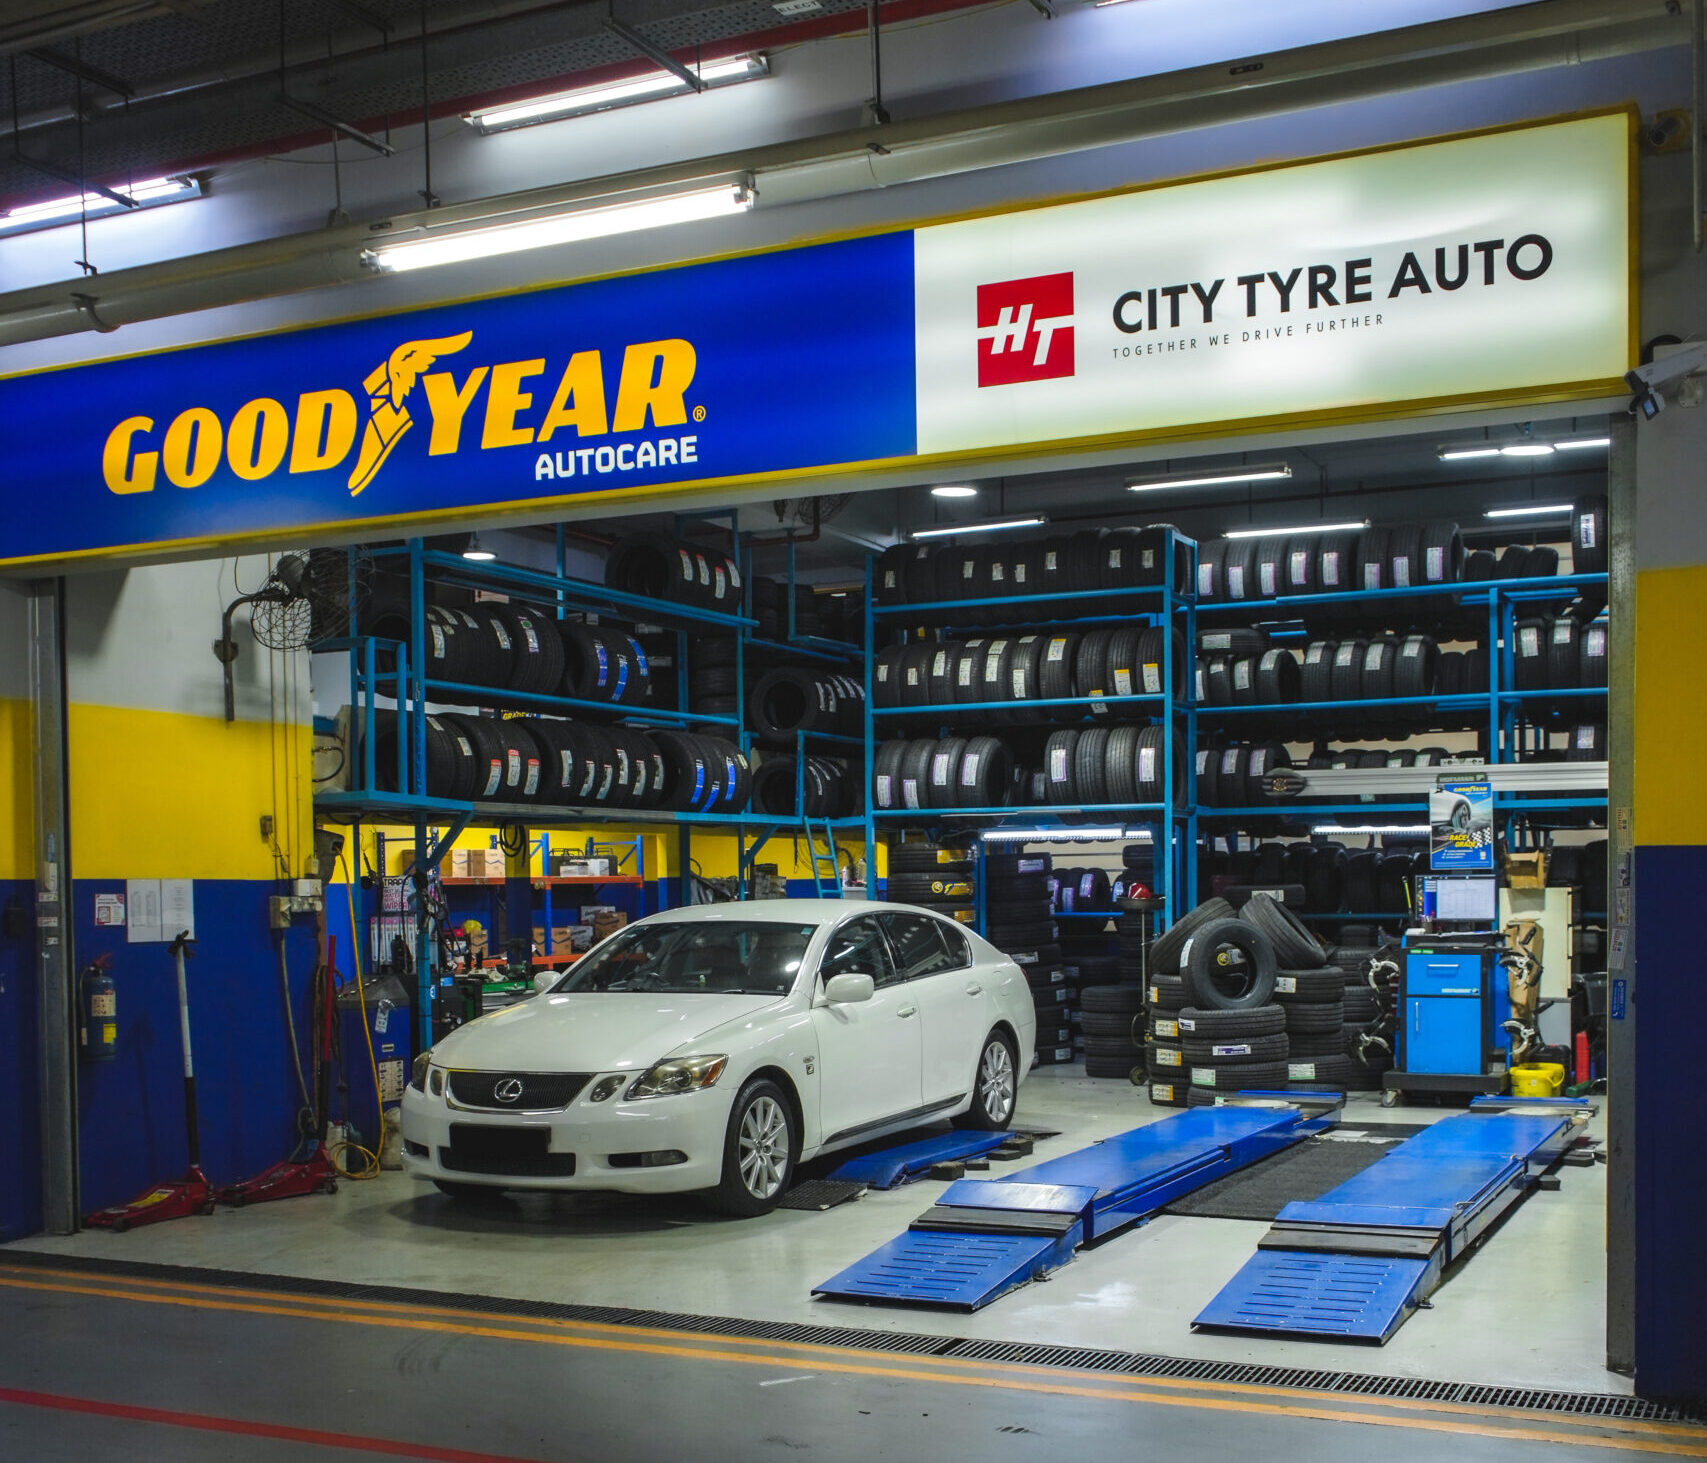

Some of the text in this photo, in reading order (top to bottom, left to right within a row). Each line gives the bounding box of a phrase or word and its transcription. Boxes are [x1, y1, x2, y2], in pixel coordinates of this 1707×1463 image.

[1112, 233, 1553, 334] CITY TYRE AUTO
[978, 303, 1074, 366] HT
[1113, 314, 1383, 359] TOGETHER WE DRIVE FURTHER
[535, 435, 698, 481] AUTOCARE
